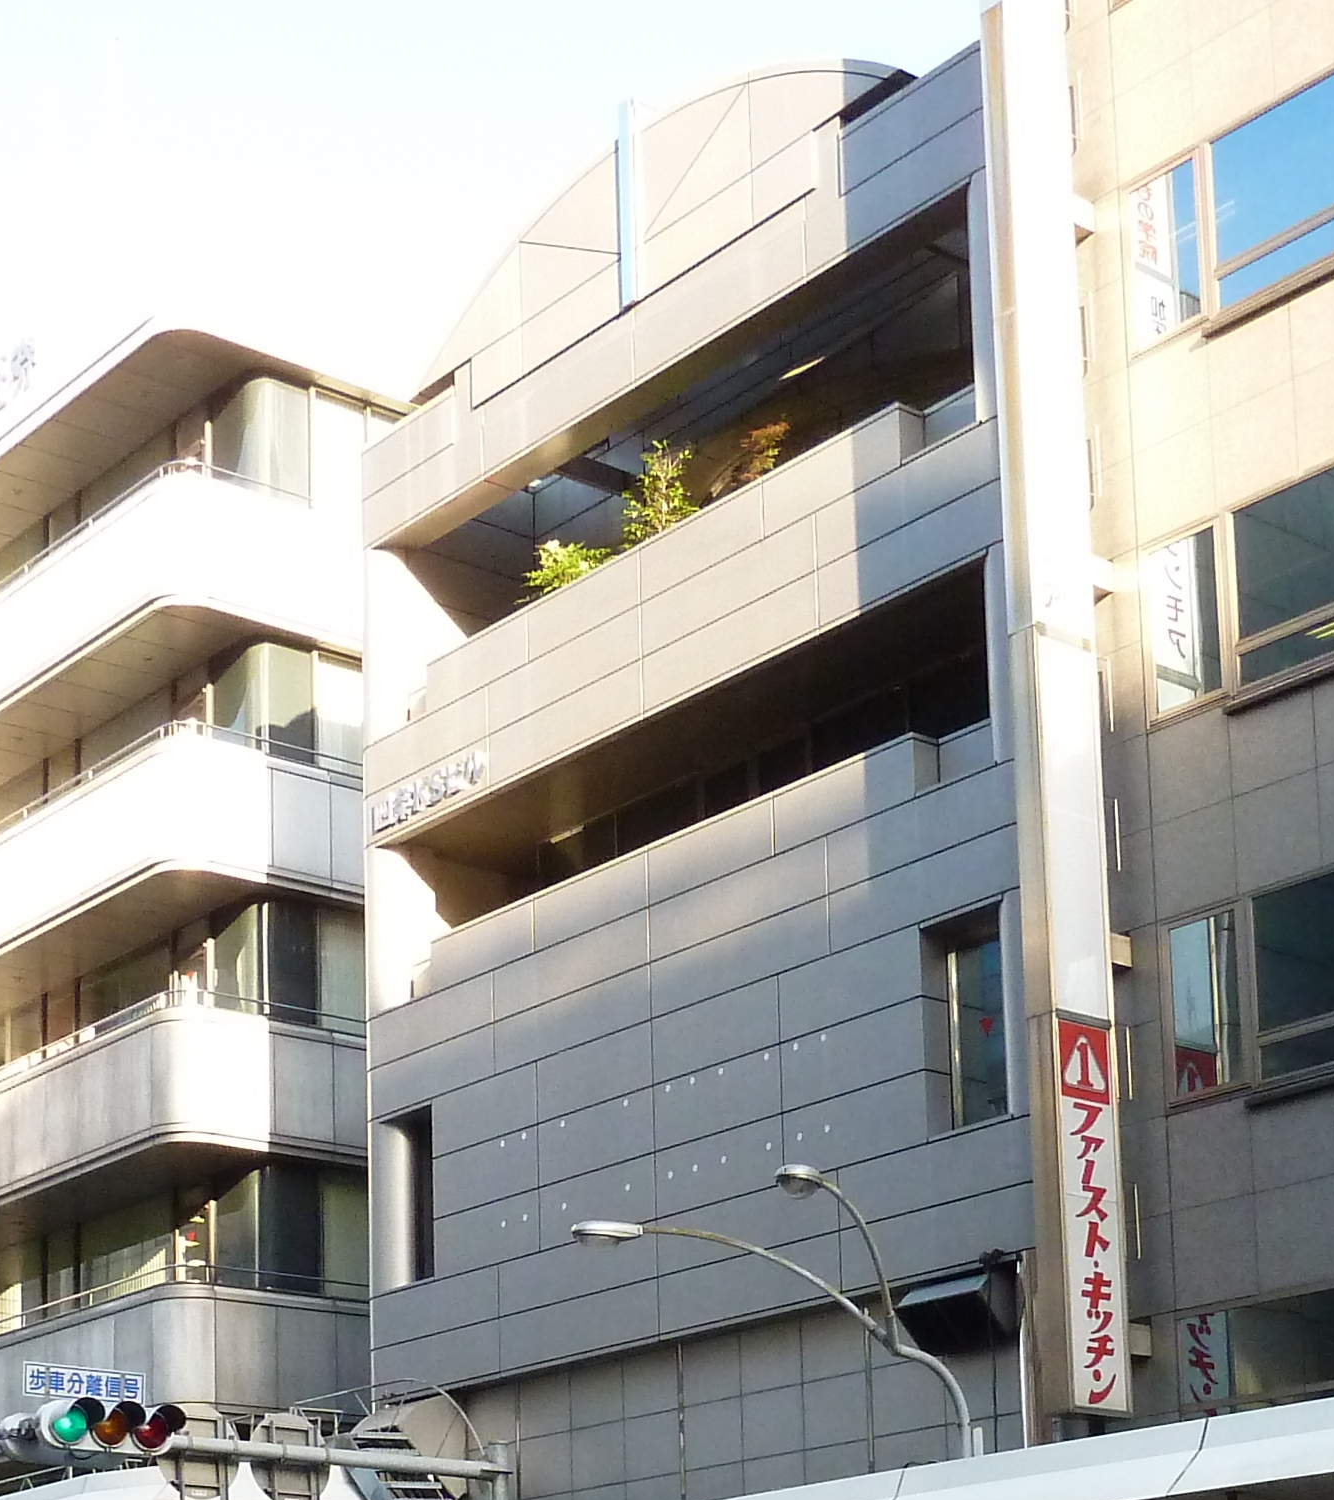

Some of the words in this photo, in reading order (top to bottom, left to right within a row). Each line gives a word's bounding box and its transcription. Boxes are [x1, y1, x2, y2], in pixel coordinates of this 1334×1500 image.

[1070, 1101, 1119, 1406] ファースト・キッチン
[29, 1369, 140, 1400] 歩車分離信号
